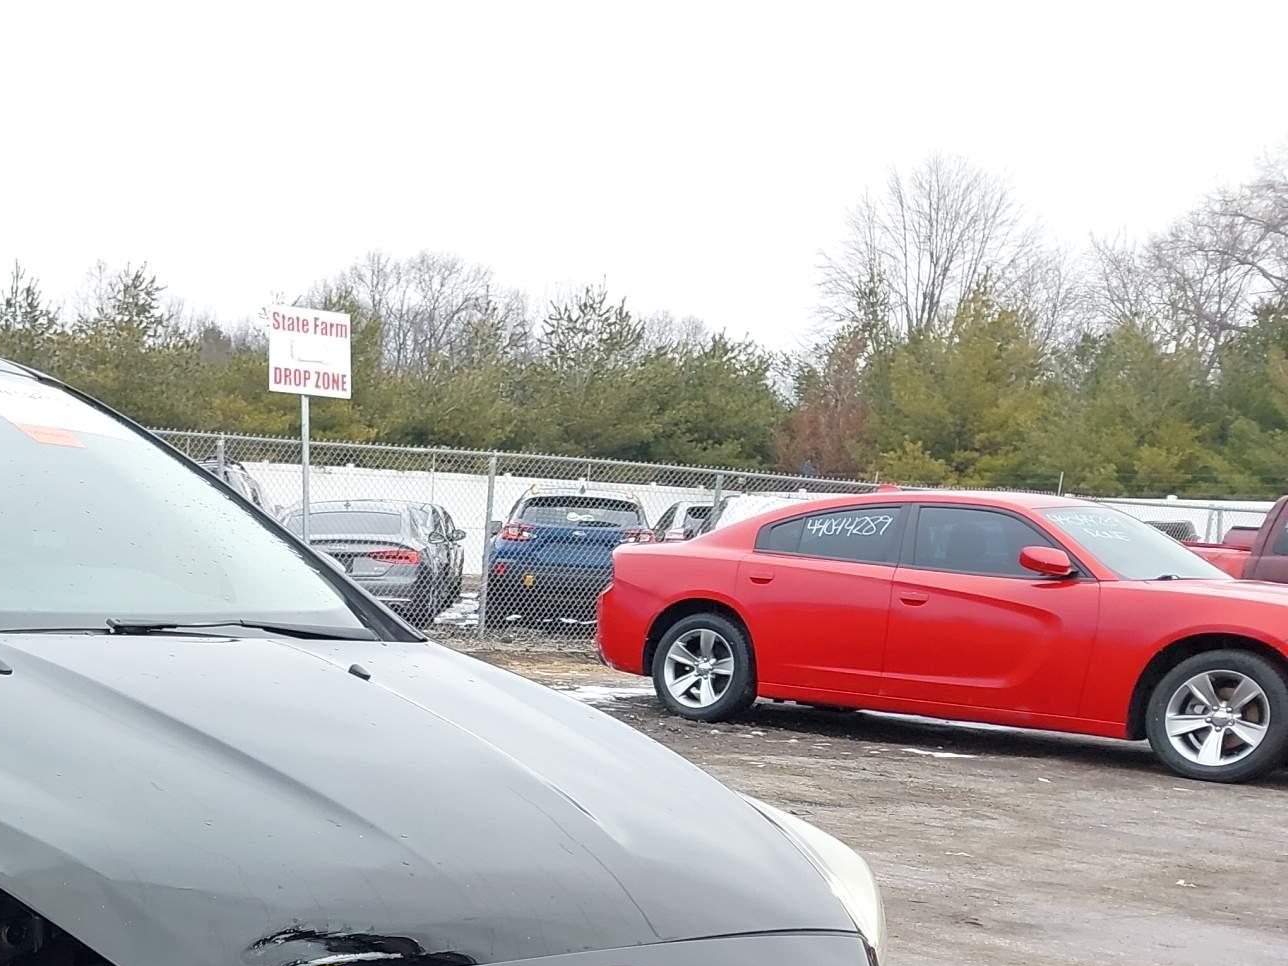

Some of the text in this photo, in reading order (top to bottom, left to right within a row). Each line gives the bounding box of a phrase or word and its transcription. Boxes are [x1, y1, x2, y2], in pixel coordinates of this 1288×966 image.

[272, 311, 348, 338] State Farm
[273, 366, 347, 392] DROP ZONE
